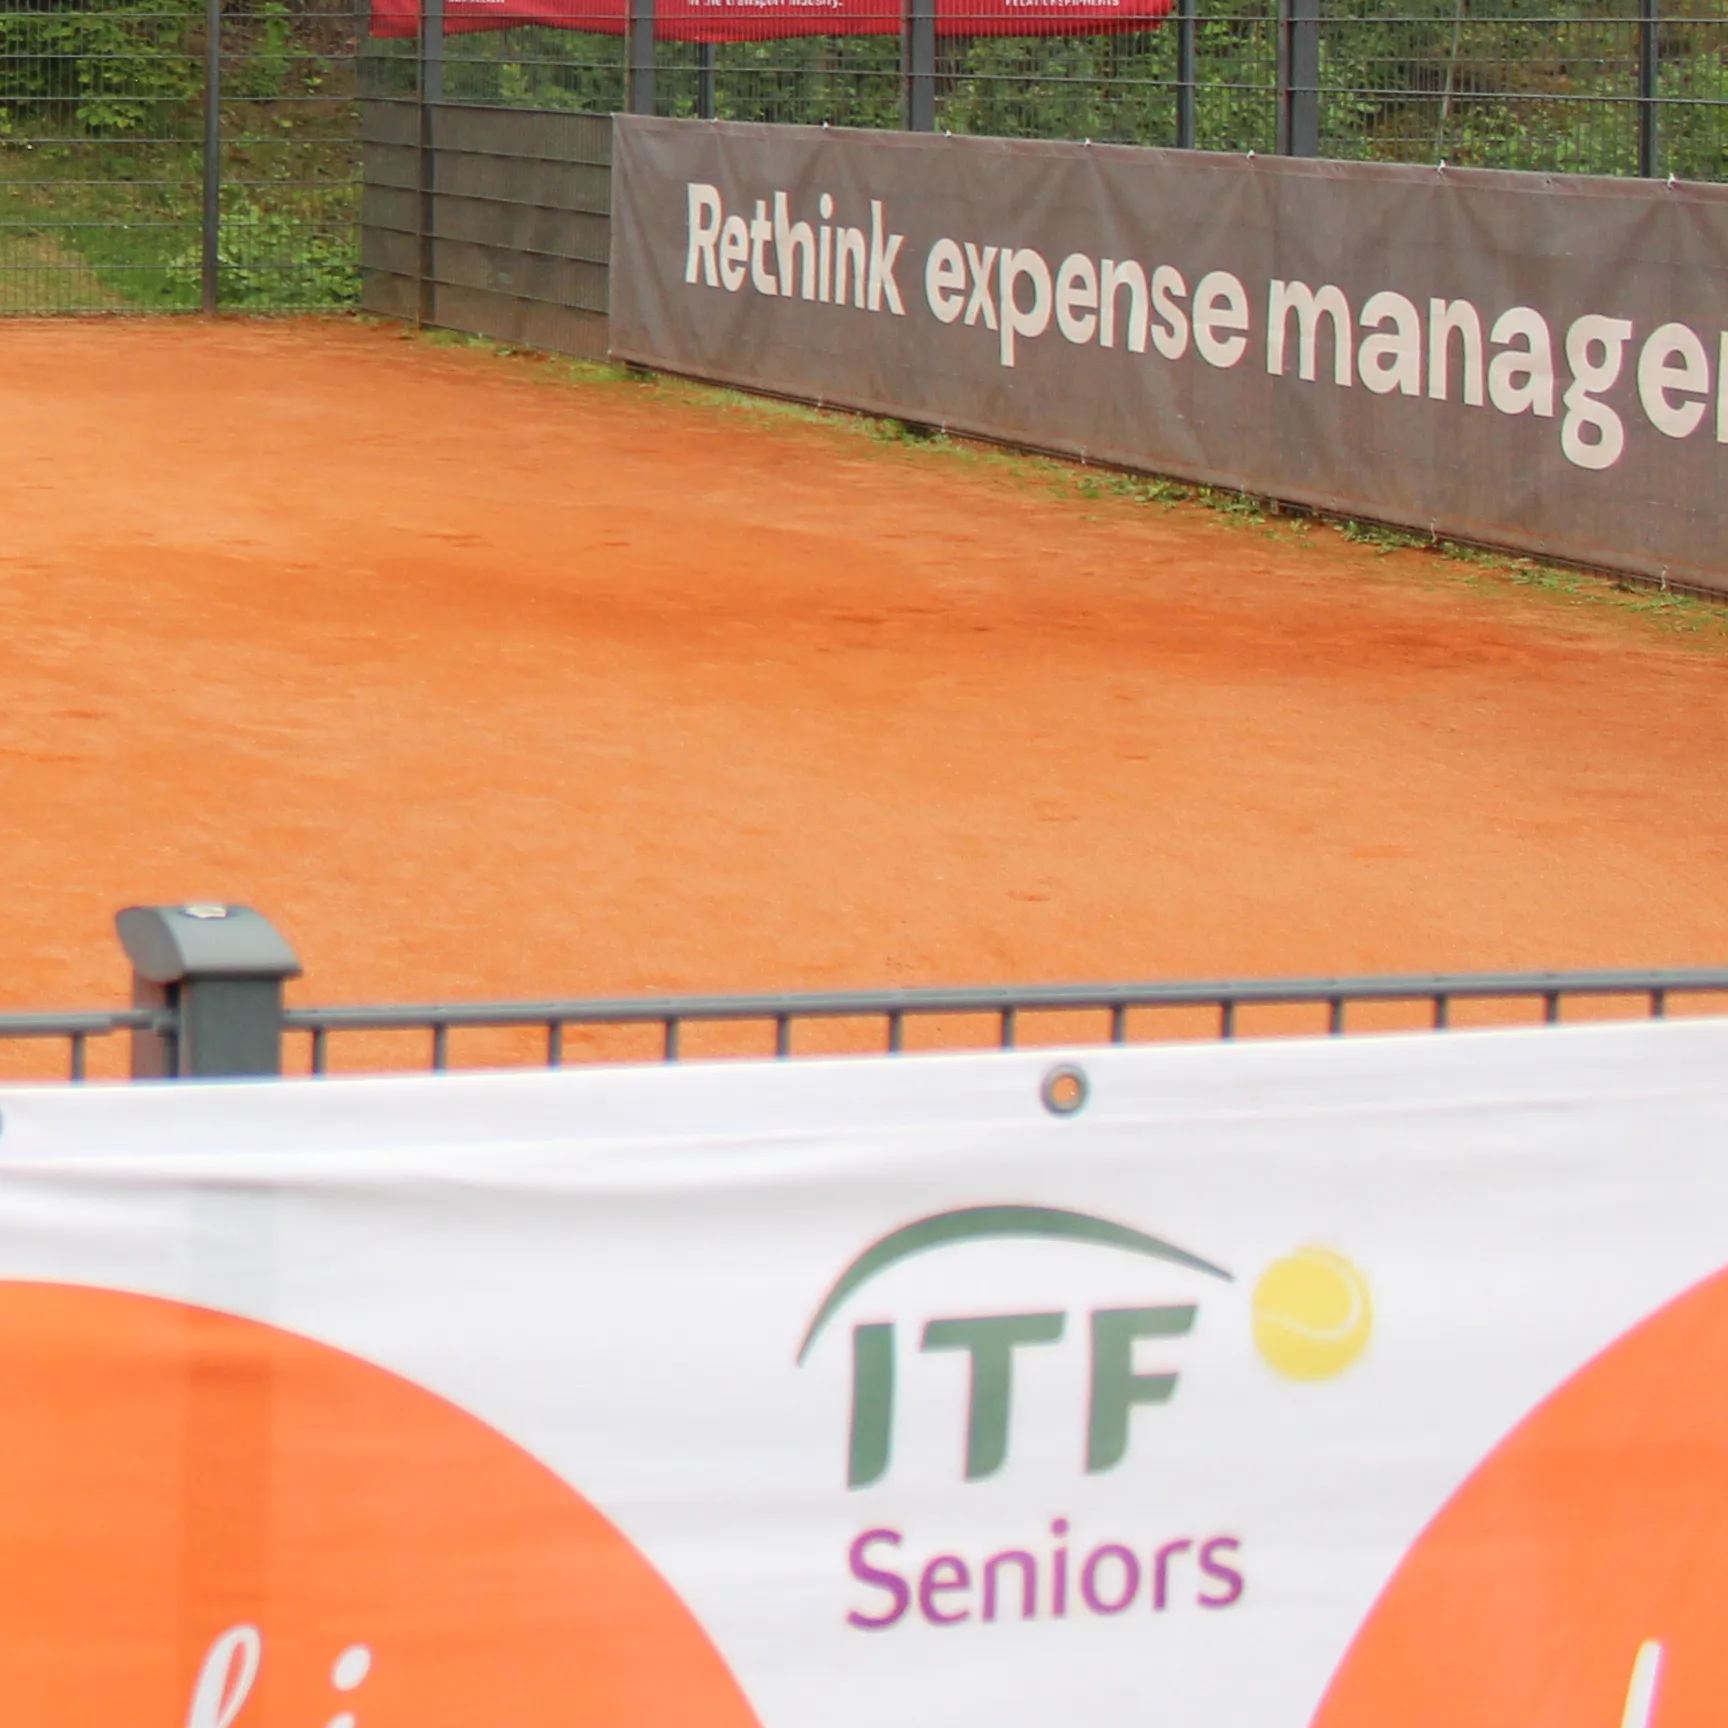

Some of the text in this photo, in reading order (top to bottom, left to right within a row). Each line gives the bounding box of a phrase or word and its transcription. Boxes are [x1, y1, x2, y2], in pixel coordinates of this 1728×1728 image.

[686, 182, 906, 315] Rethink
[925, 237, 1251, 368] expense
[847, 1304, 1198, 1490] ITF
[846, 1518, 1244, 1631] Seniors
